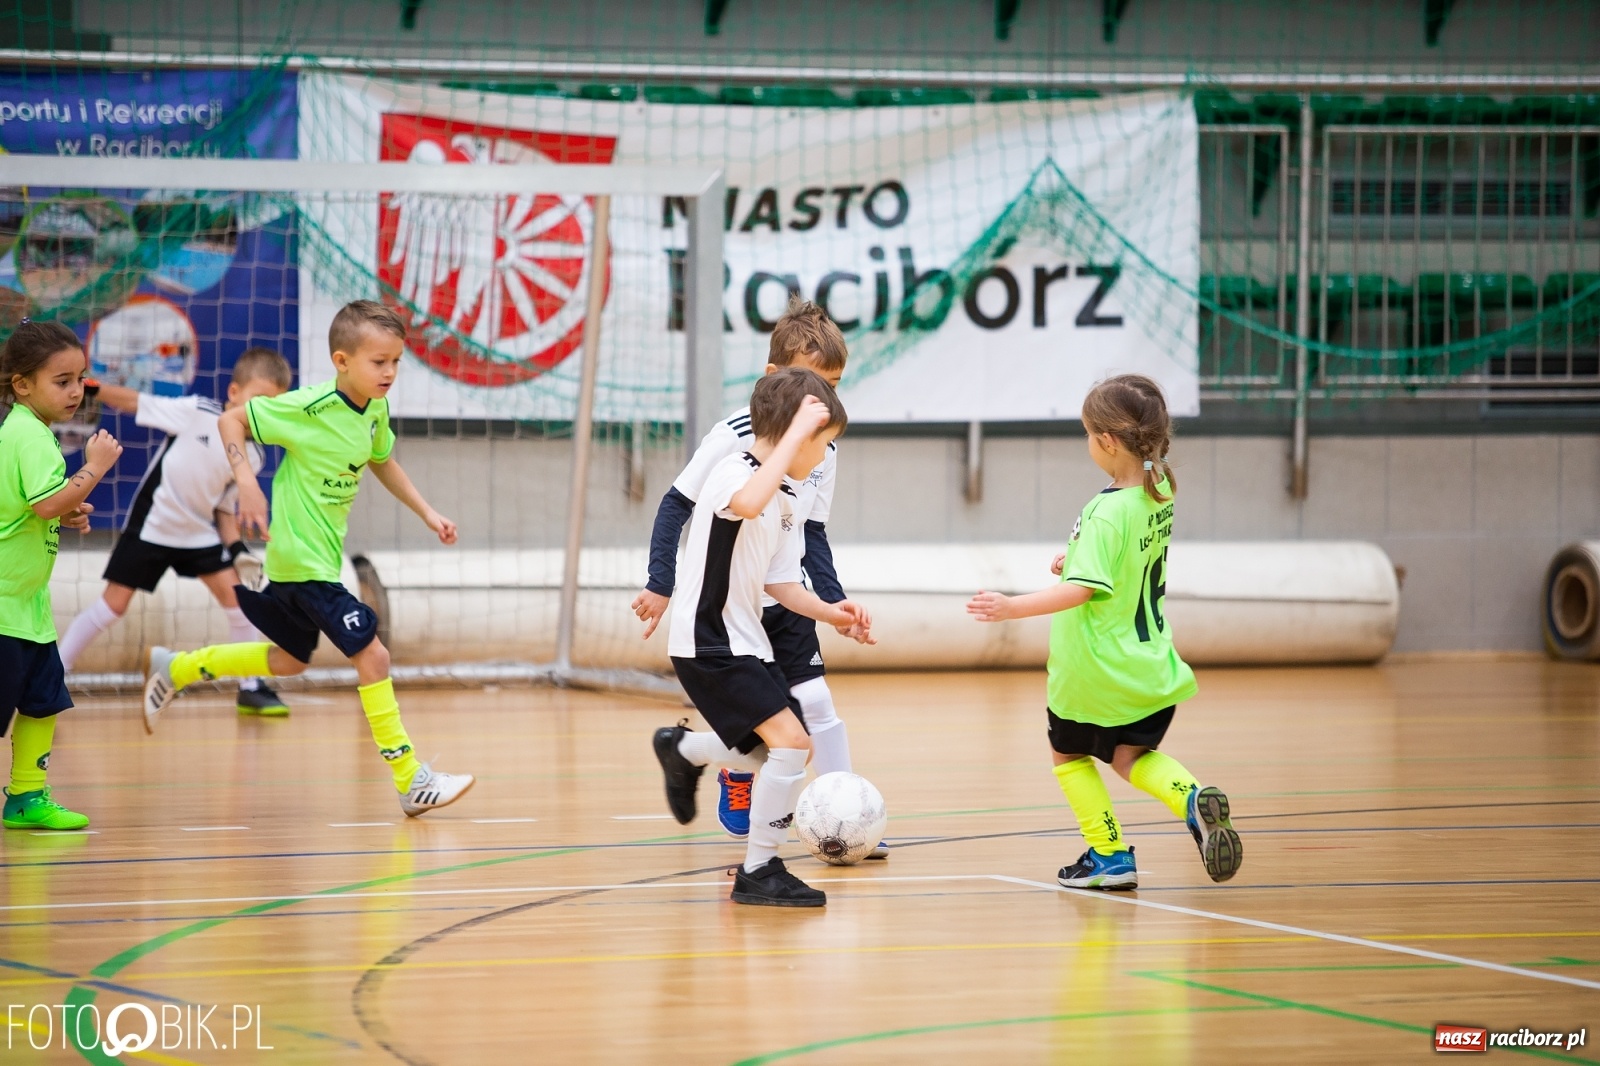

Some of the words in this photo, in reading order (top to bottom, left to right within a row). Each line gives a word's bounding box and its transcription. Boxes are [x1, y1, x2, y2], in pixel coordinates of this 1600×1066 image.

[0, 98, 72, 125] portu
[79, 99, 87, 123] i
[95, 98, 222, 130] Rekreacji
[56, 138, 82, 157] w
[662, 180, 909, 232] MIASTO
